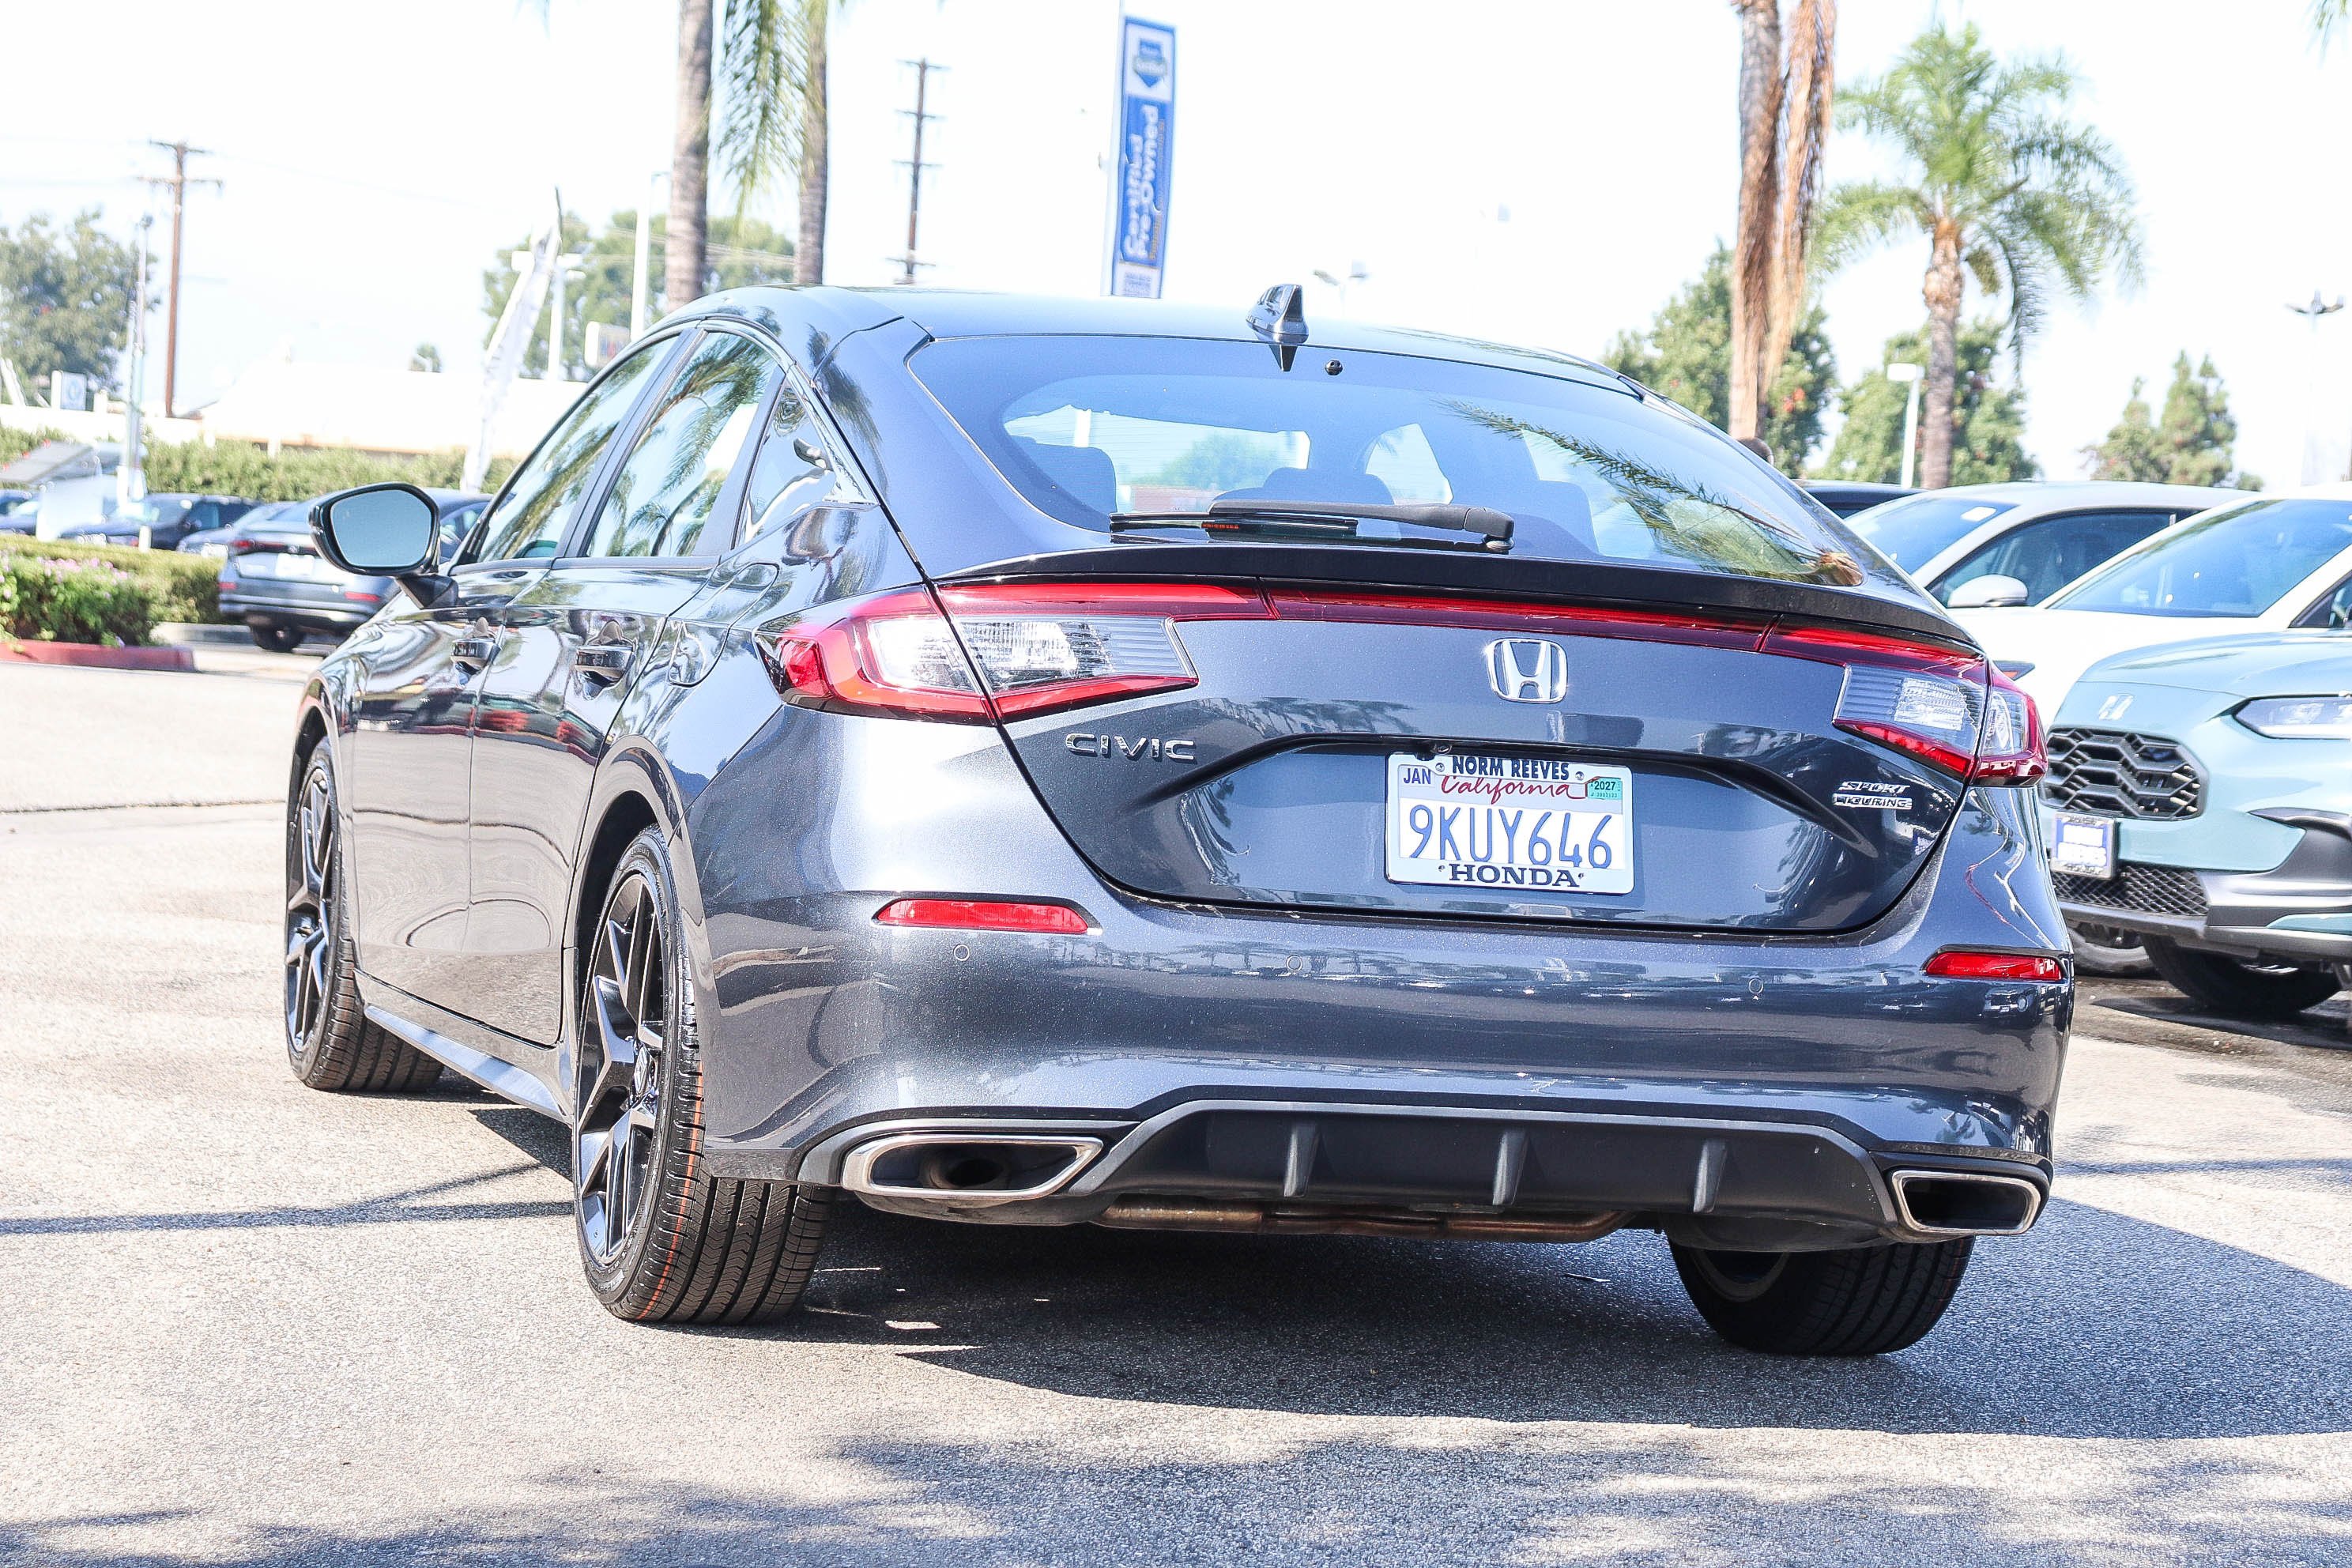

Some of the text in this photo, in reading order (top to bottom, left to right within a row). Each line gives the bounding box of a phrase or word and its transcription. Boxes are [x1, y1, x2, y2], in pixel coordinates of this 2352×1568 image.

[1065, 733, 1195, 760] CIVIC
[1403, 767, 1432, 785] JAN
[1452, 756, 1570, 781] NORM REEVES
[1441, 775, 1586, 805] California
[1593, 780, 1616, 791] 2027
[1838, 781, 1911, 795] SPORT
[1835, 795, 1909, 808] TOURING
[1409, 804, 1613, 869] 9KUY646
[1449, 863, 1581, 888] HONDA
